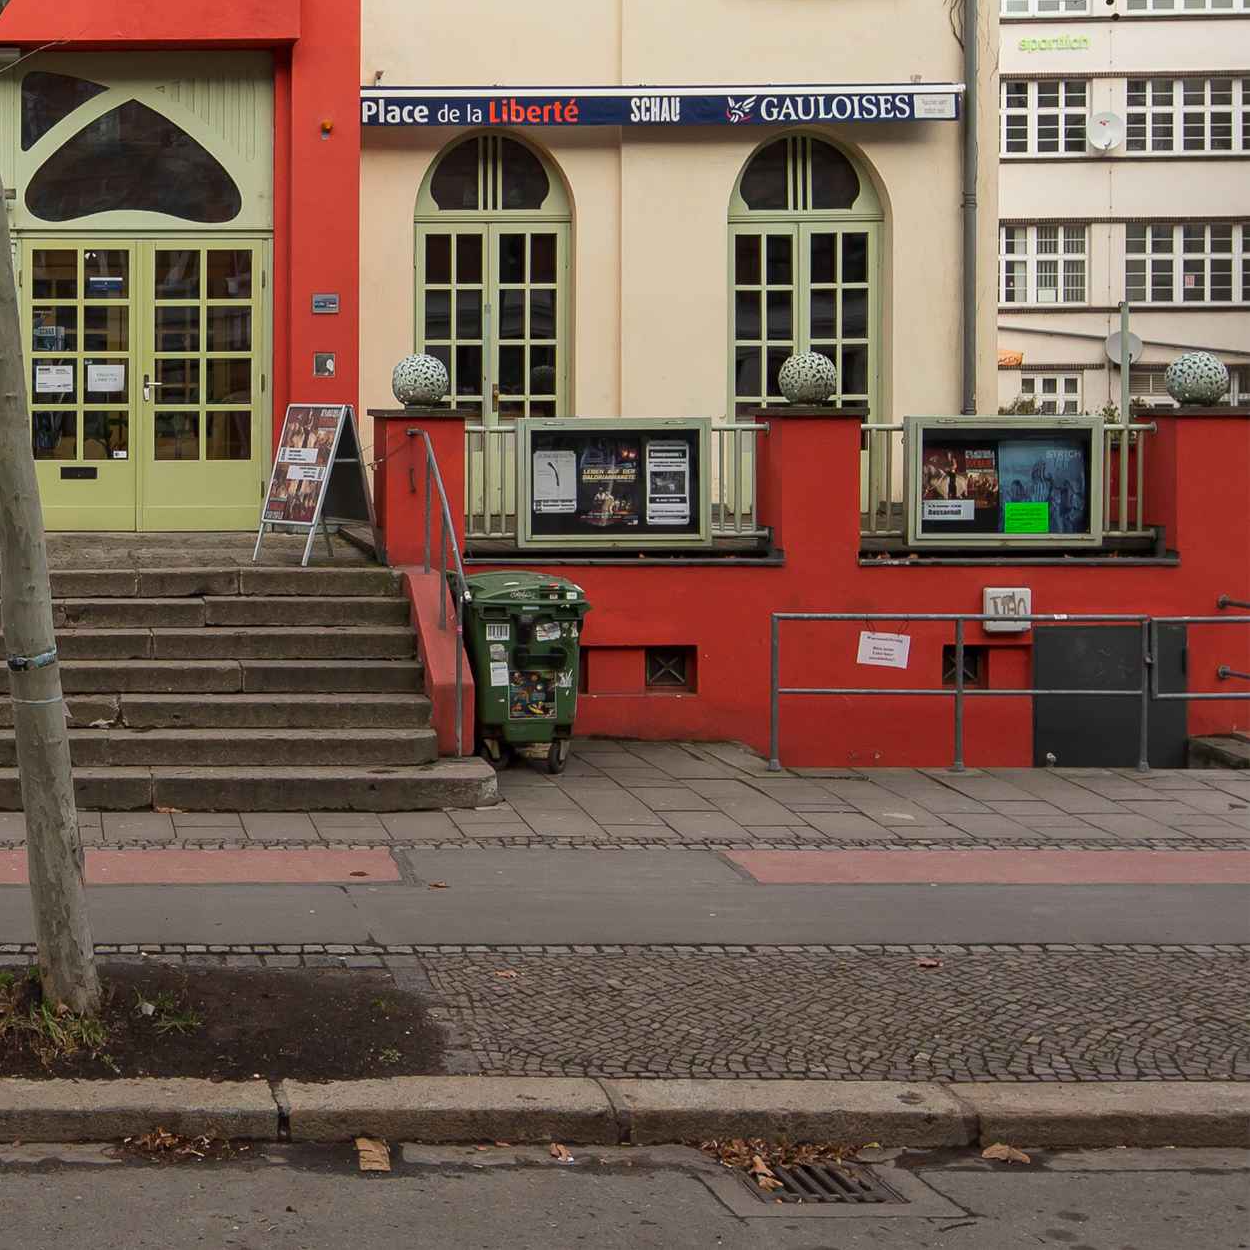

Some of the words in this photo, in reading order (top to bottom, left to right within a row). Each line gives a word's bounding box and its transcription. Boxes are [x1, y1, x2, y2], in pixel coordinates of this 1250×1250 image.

[361, 99, 429, 124] Place
[437, 103, 460, 124] de
[467, 103, 482, 123] la
[489, 98, 580, 123] Liberté
[630, 96, 681, 123] SCHAU
[760, 94, 910, 121] GAULOISES
